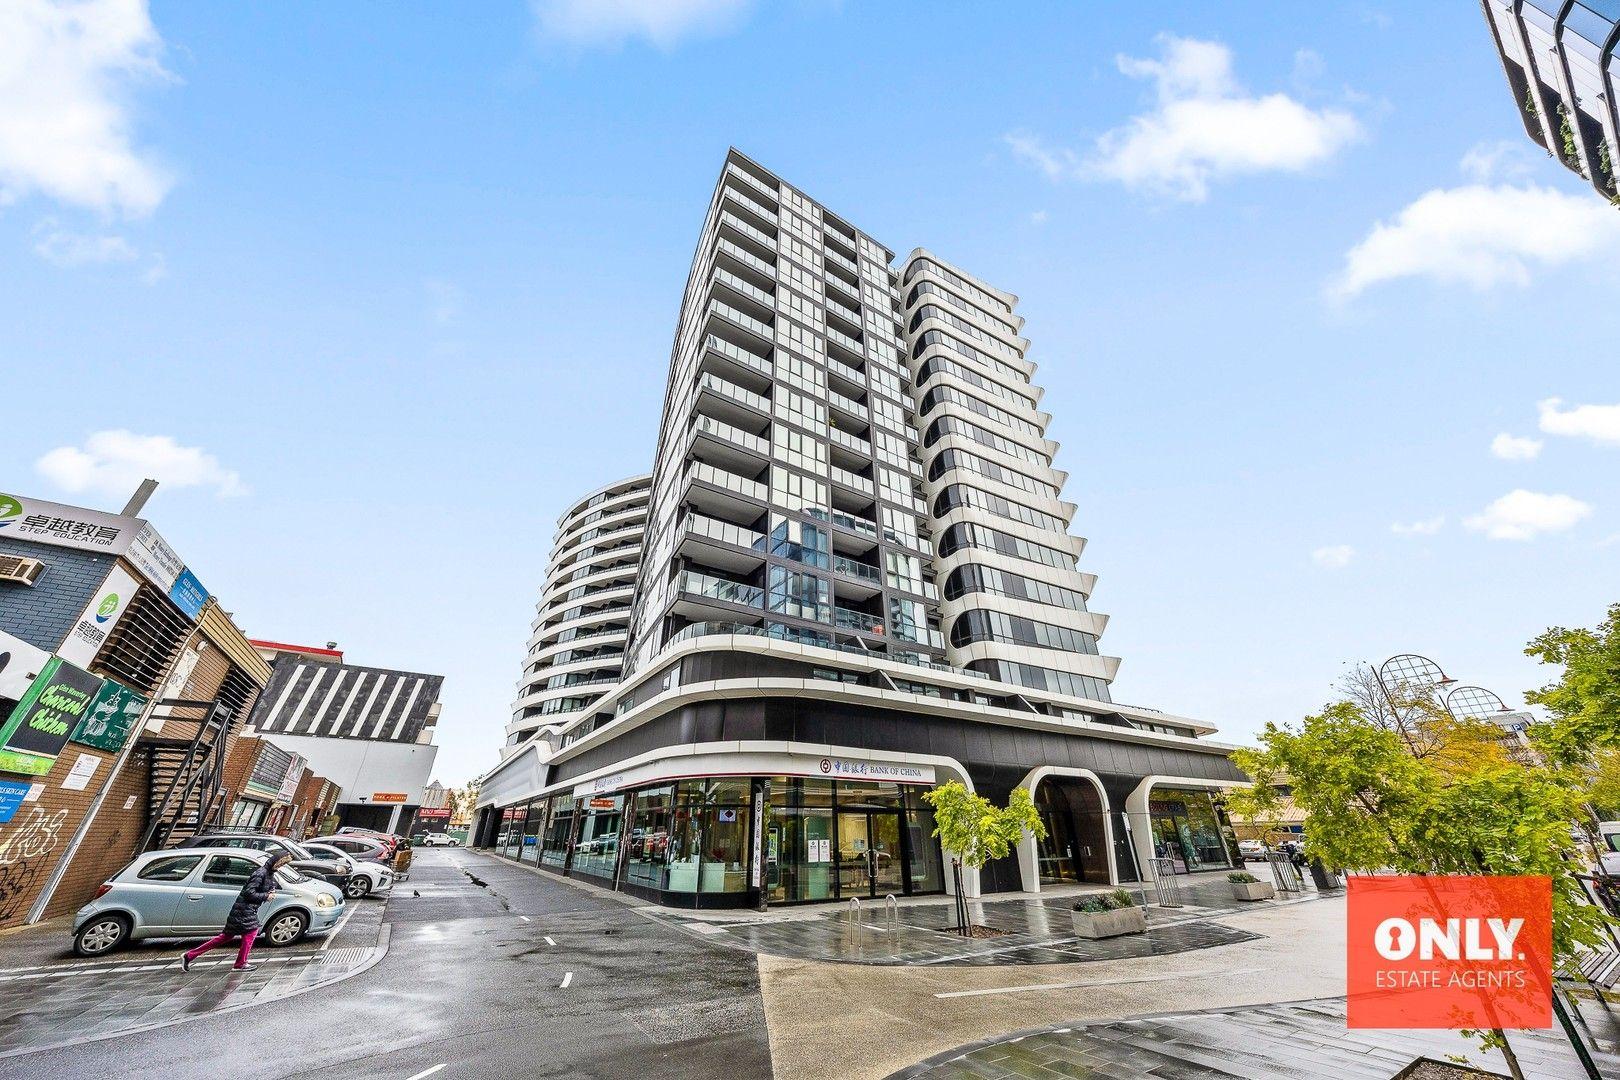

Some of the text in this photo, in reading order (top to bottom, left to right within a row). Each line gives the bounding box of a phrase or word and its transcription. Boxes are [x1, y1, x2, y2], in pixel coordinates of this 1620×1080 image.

[18, 525, 112, 546] STEP EDUCATION
[22, 514, 121, 540] 卓越教育
[39, 684, 91, 716] Charcoal
[29, 707, 69, 736] Chicken
[834, 760, 868, 775] 中国银行
[870, 766, 922, 777] BANK OF CHINA
